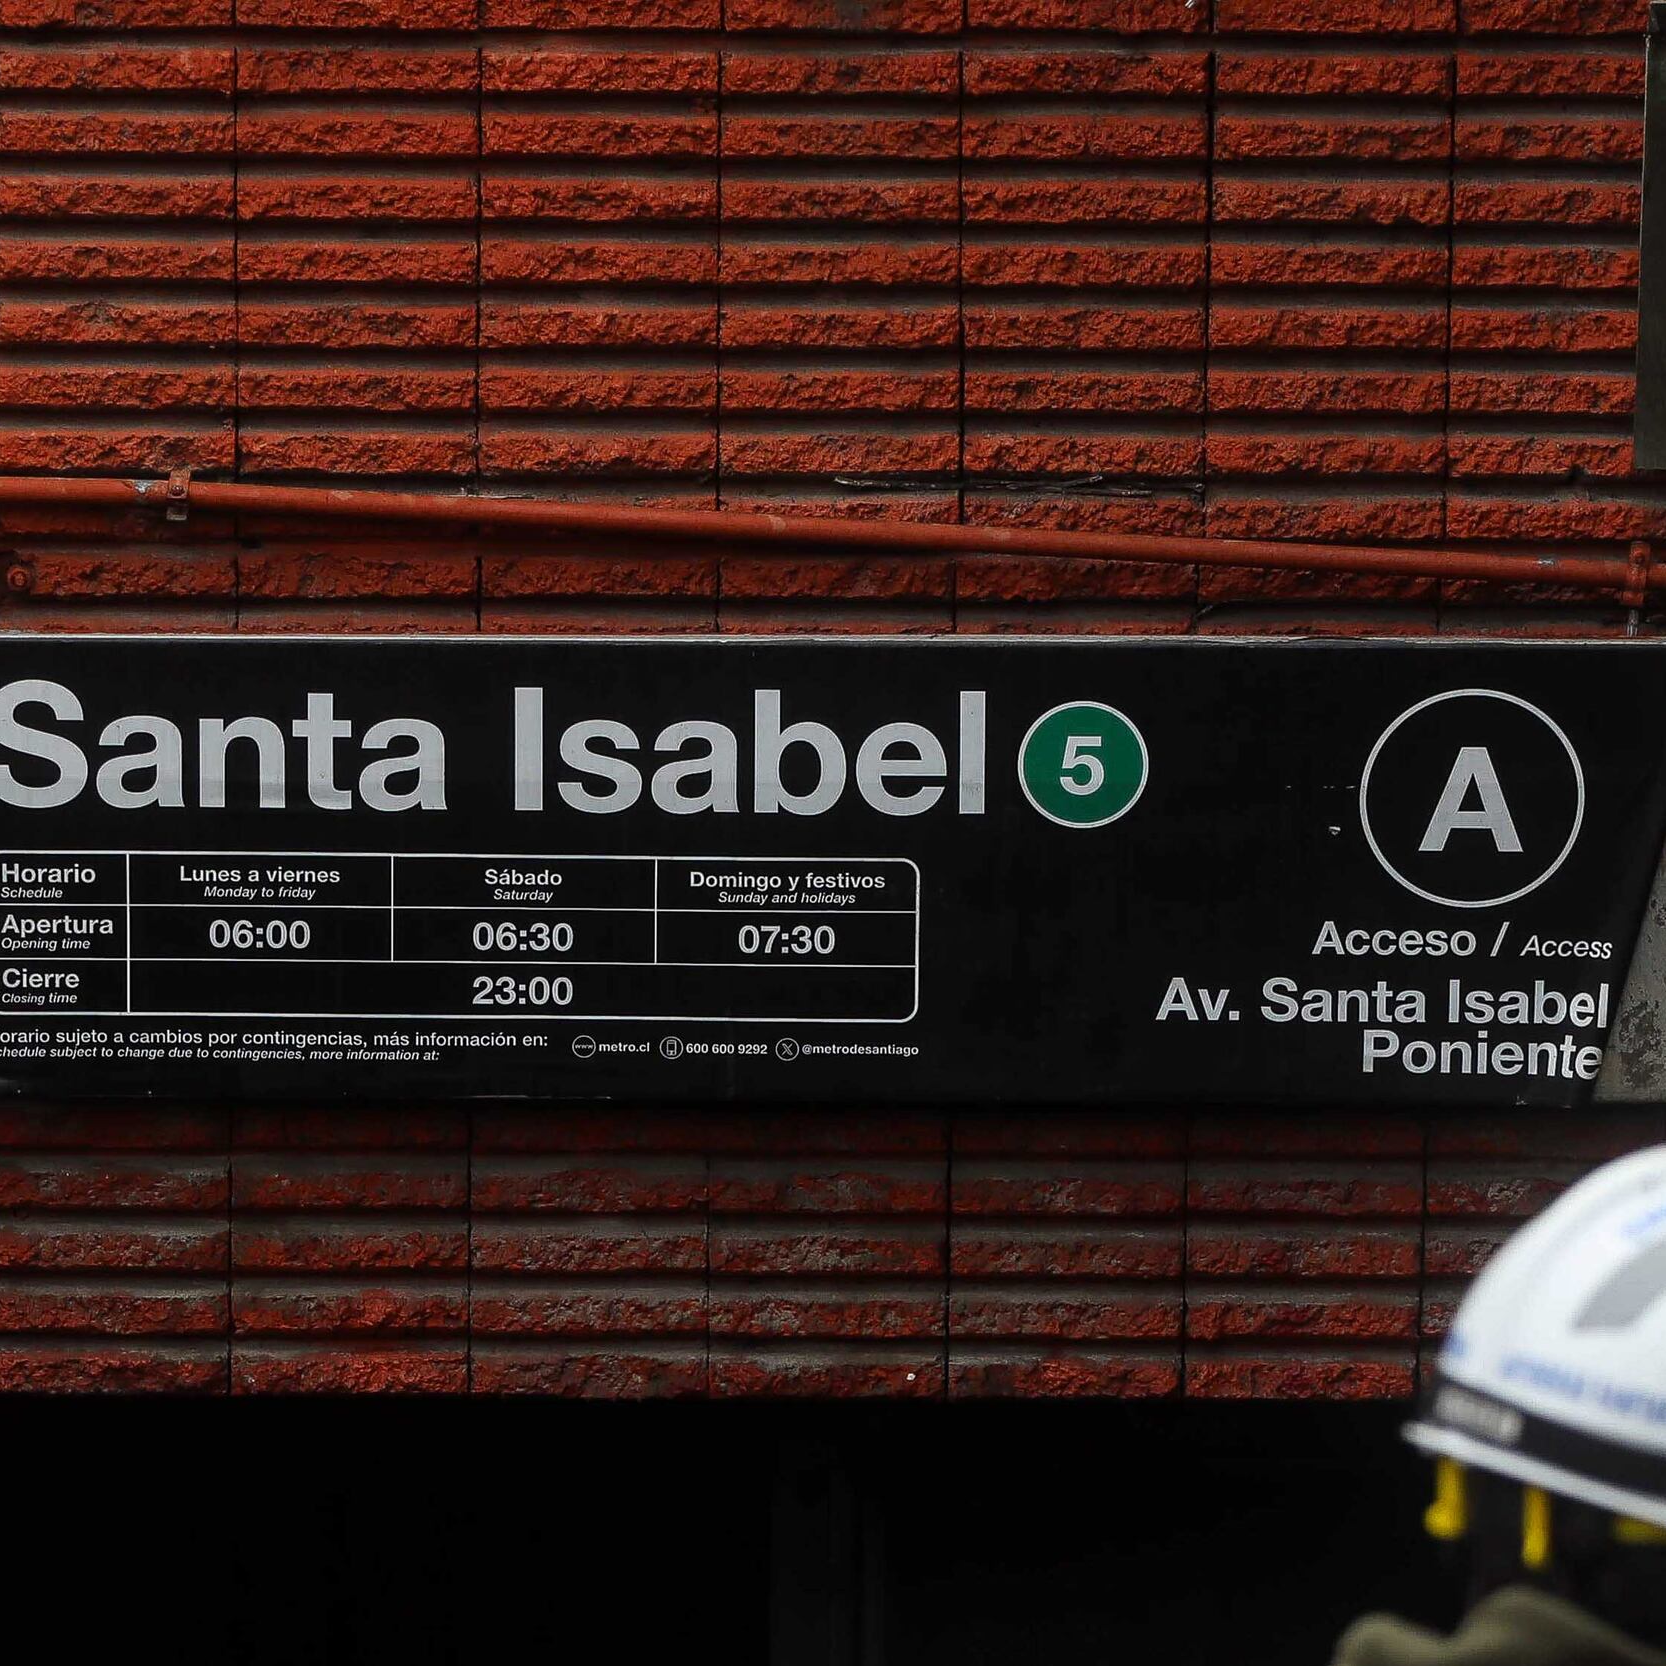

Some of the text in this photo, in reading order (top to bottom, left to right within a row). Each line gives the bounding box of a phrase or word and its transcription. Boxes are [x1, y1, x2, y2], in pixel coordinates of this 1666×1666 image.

[515, 687, 986, 816] Isabel
[1060, 736, 1104, 795] 5
[1418, 747, 1523, 852] A
[2, 863, 95, 883] Horario
[181, 866, 340, 882] Lunes a viernes
[485, 869, 562, 885] Sábado
[691, 872, 885, 891] Domingo y festivos
[1, 887, 63, 898] Schedule
[204, 886, 316, 900] Monday to friday
[494, 889, 553, 903] Saturday
[719, 892, 855, 906] Sunday and holidays
[1, 914, 113, 938] Apertura
[210, 920, 310, 948] 06:00
[1, 938, 90, 951] Opening time
[473, 922, 573, 951] 06:30
[739, 925, 835, 954] 07:30
[1312, 921, 1612, 959] Acceso / Access
[3, 968, 79, 988] Cierre
[2, 992, 77, 1005] Closing time
[473, 976, 573, 1005] 23:00
[1156, 977, 1609, 1028] Av. Santa Isabel
[56, 1029, 107, 1049] sujeto
[114, 1033, 124, 1043] a
[130, 1029, 202, 1043] cambios
[209, 1033, 237, 1047] por
[243, 1031, 367, 1050] contingencias,
[374, 1031, 409, 1046] más
[416, 1032, 517, 1046] información
[523, 1036, 547, 1046] en:
[599, 1042, 650, 1052] metro.cl
[686, 1043, 767, 1054] 600 600 9292
[50, 1047, 97, 1059] subject
[101, 1047, 113, 1057] to
[118, 1047, 164, 1060] change
[168, 1047, 192, 1058] due
[197, 1048, 209, 1058] to
[213, 1047, 305, 1061] contingencies,
[310, 1051, 343, 1059] more
[347, 1049, 419, 1060] information
[423, 1051, 439, 1060] at:
[802, 1044, 919, 1056] @metrodesantiago
[1363, 1030, 1602, 1079] Poniente
